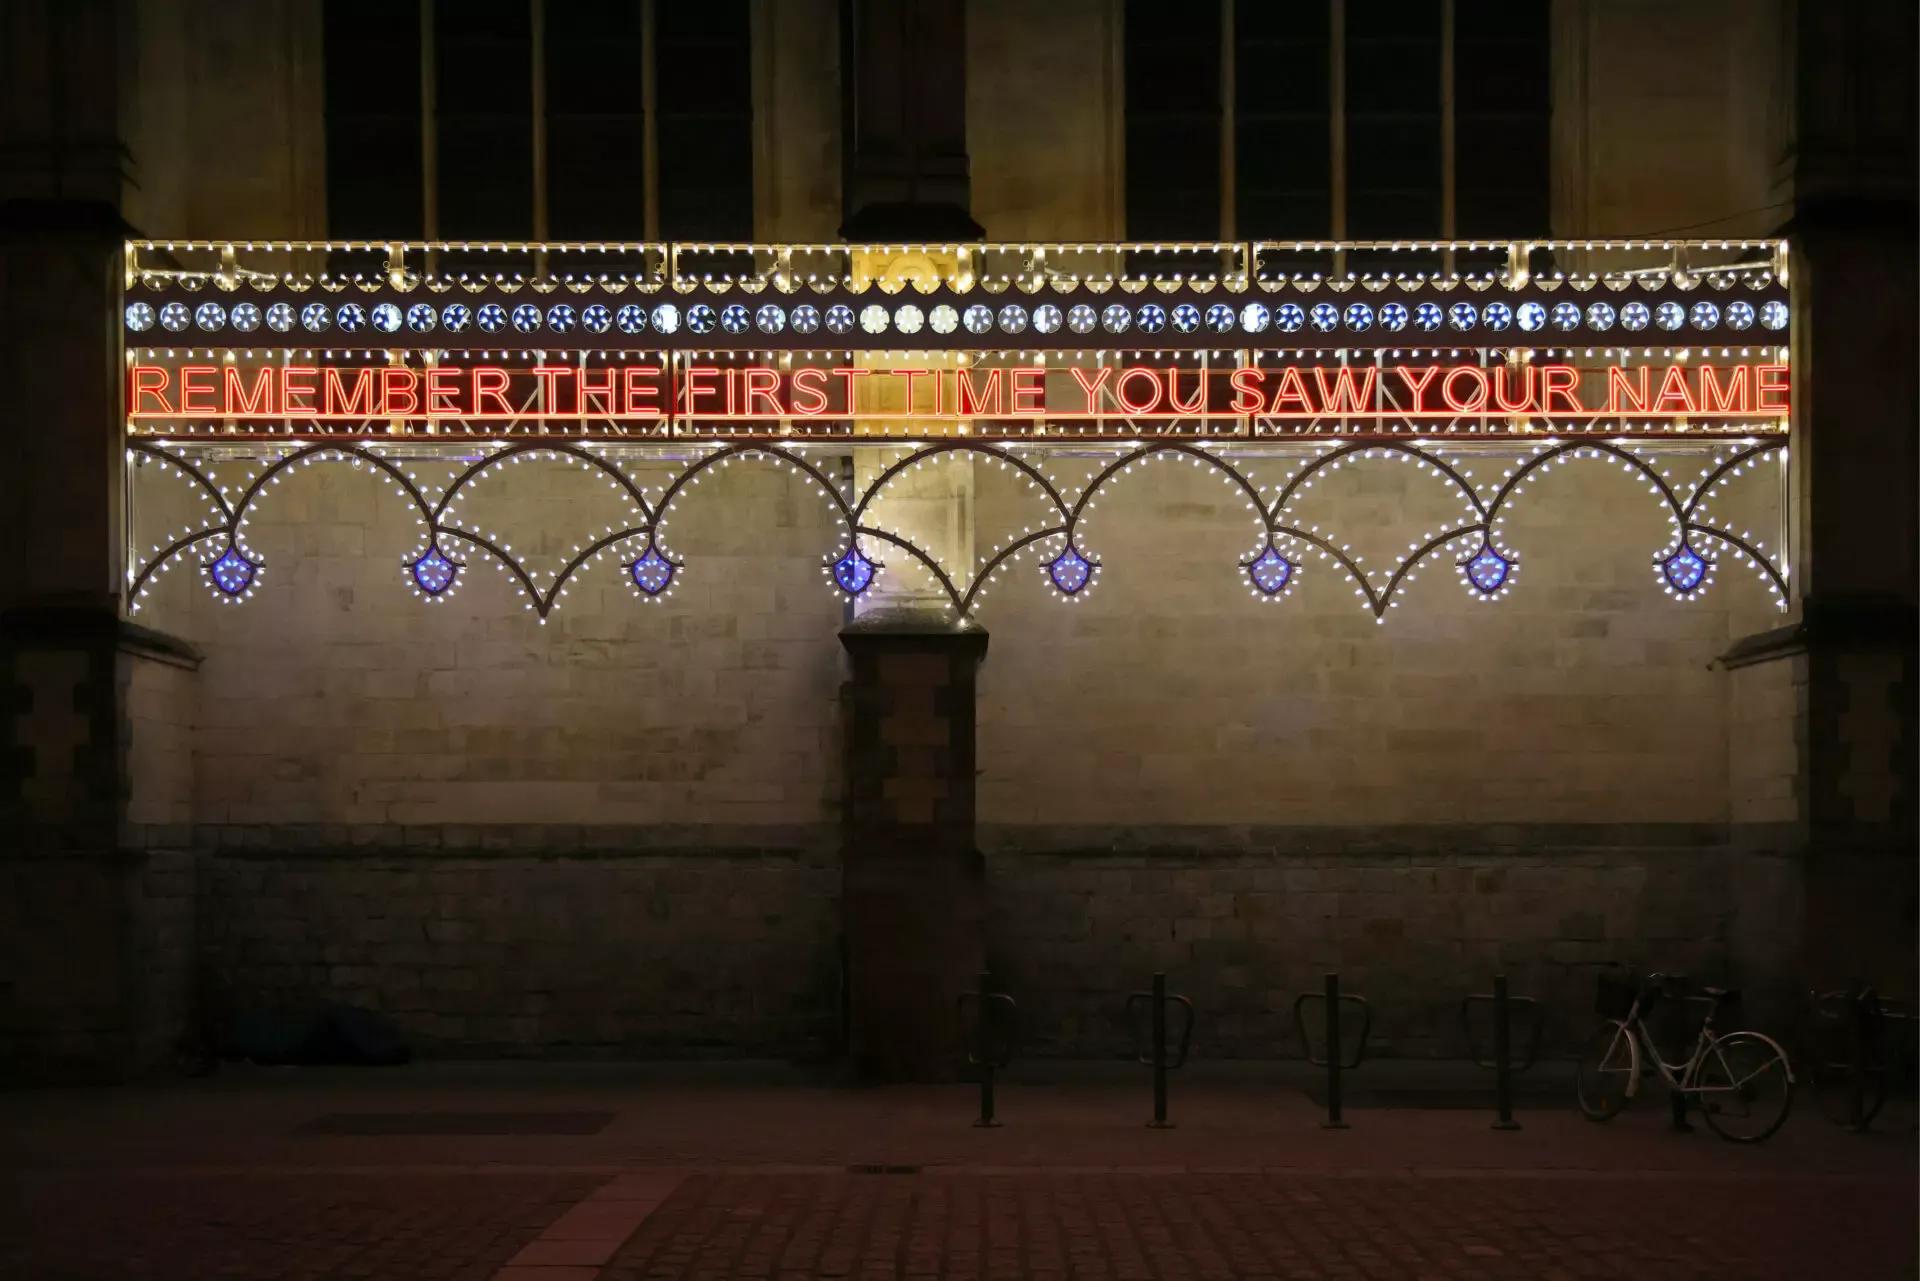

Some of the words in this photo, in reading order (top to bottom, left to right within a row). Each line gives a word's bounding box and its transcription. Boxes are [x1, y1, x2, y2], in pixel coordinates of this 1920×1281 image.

[131, 366, 514, 415] REMEMBER
[533, 367, 660, 415] THE
[685, 367, 870, 415] FIRST
[891, 367, 1046, 415] TIME
[1071, 366, 1208, 415] YOU
[1230, 366, 1376, 414] SAW
[1397, 365, 1583, 414] YOUR
[1608, 365, 1790, 413] NAME
